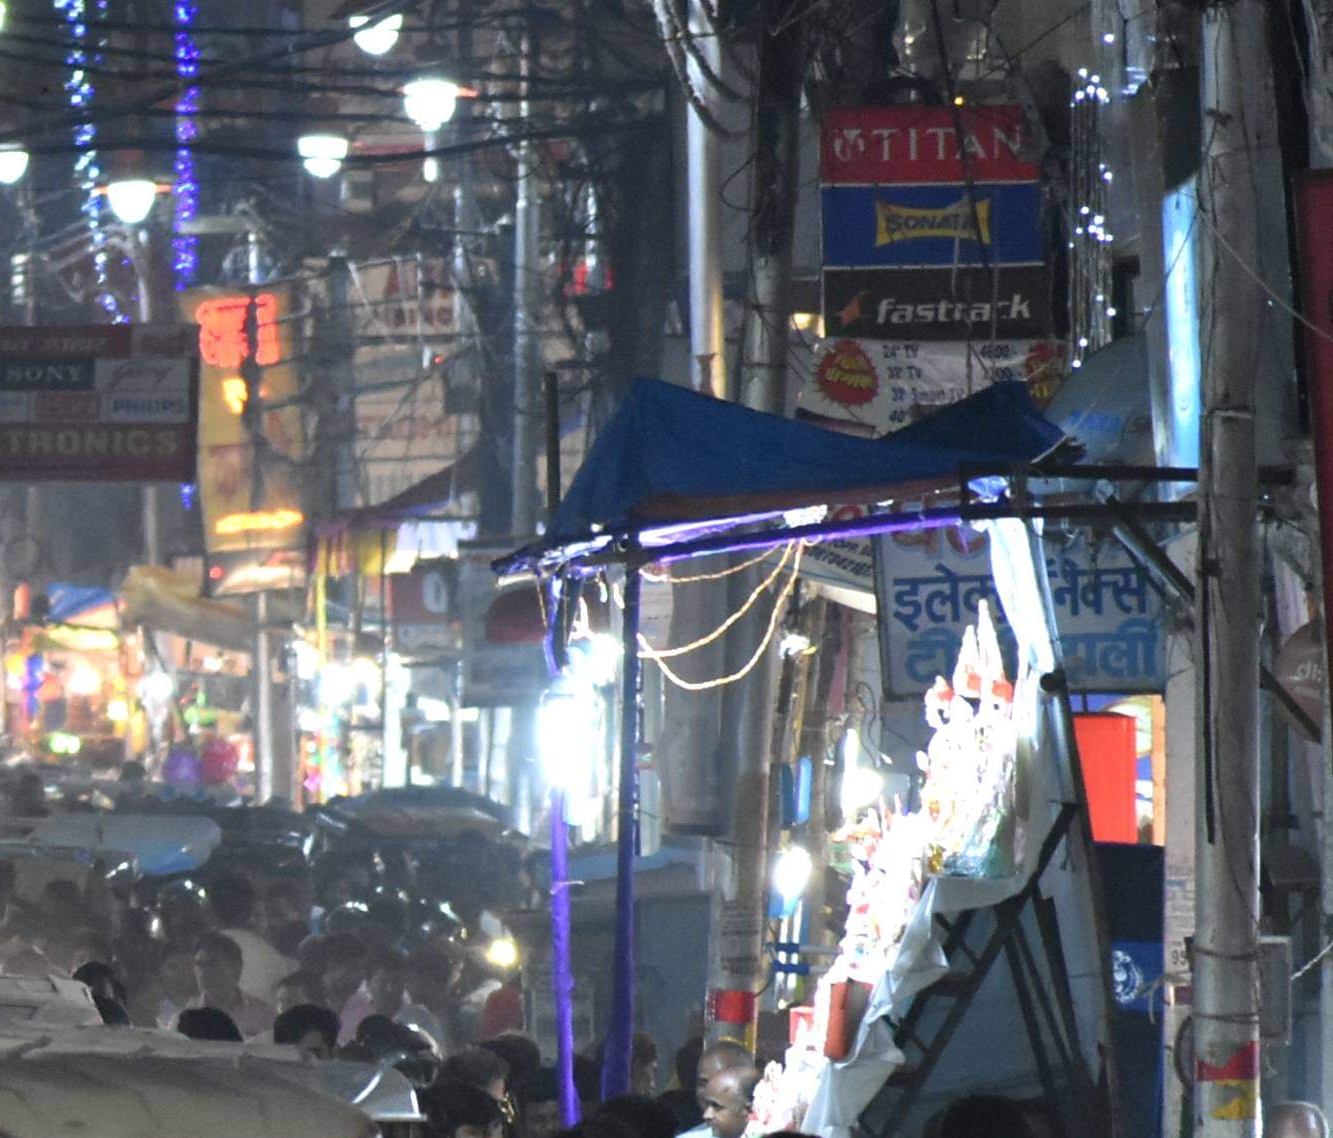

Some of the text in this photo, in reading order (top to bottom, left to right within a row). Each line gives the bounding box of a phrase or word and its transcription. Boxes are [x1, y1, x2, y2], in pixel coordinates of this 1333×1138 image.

[871, 125, 1022, 161] TITAN
[876, 293, 1031, 325] fastrack
[6, 366, 83, 384] SONY
